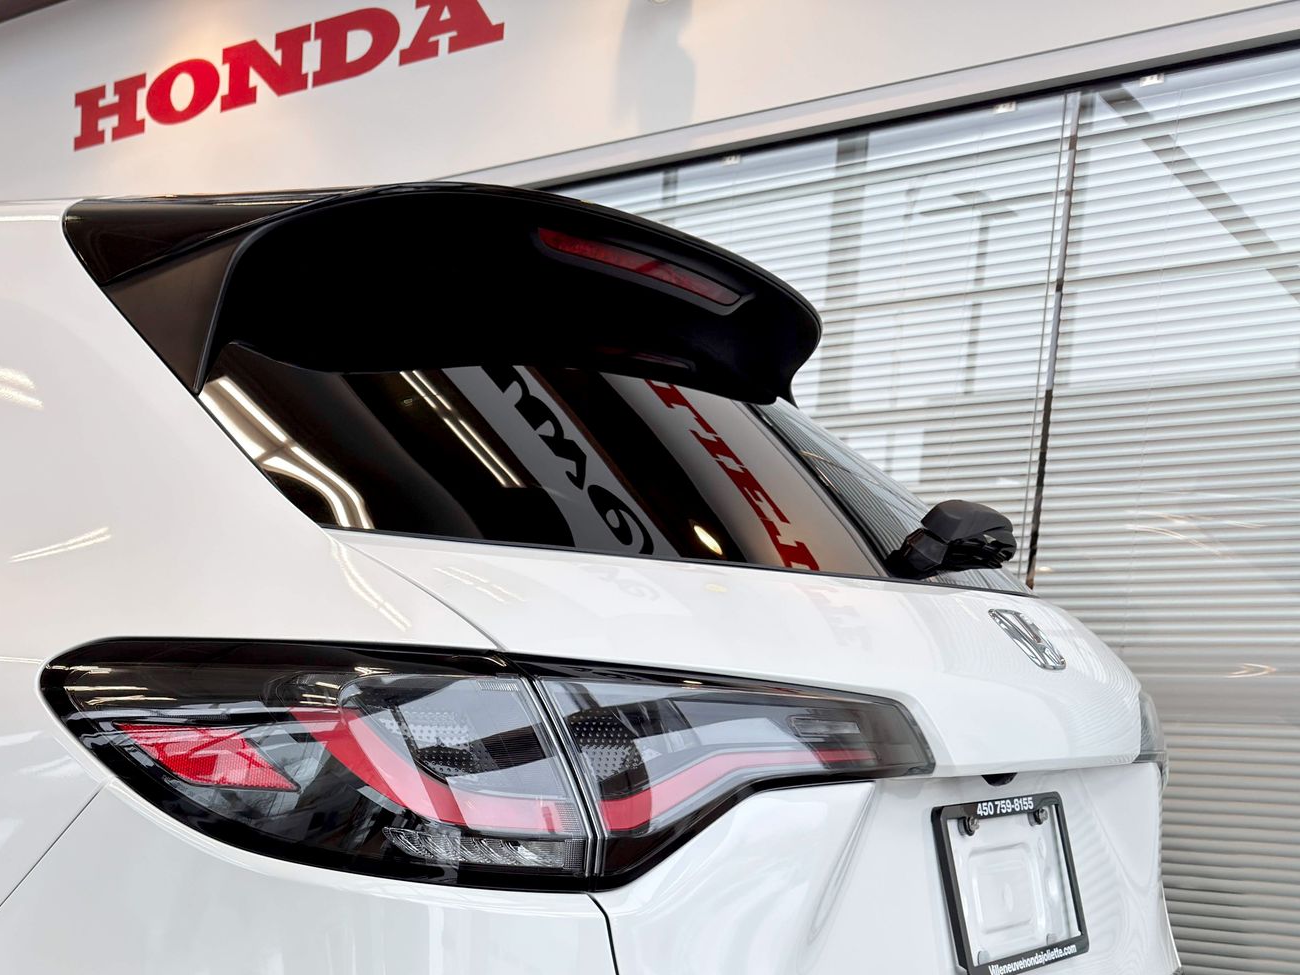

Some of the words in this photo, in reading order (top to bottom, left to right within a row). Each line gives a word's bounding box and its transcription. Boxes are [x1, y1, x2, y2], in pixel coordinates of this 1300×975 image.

[73, 0, 505, 151] HONDA
[976, 802, 994, 816] 450
[995, 797, 1034, 814] 759-8155
